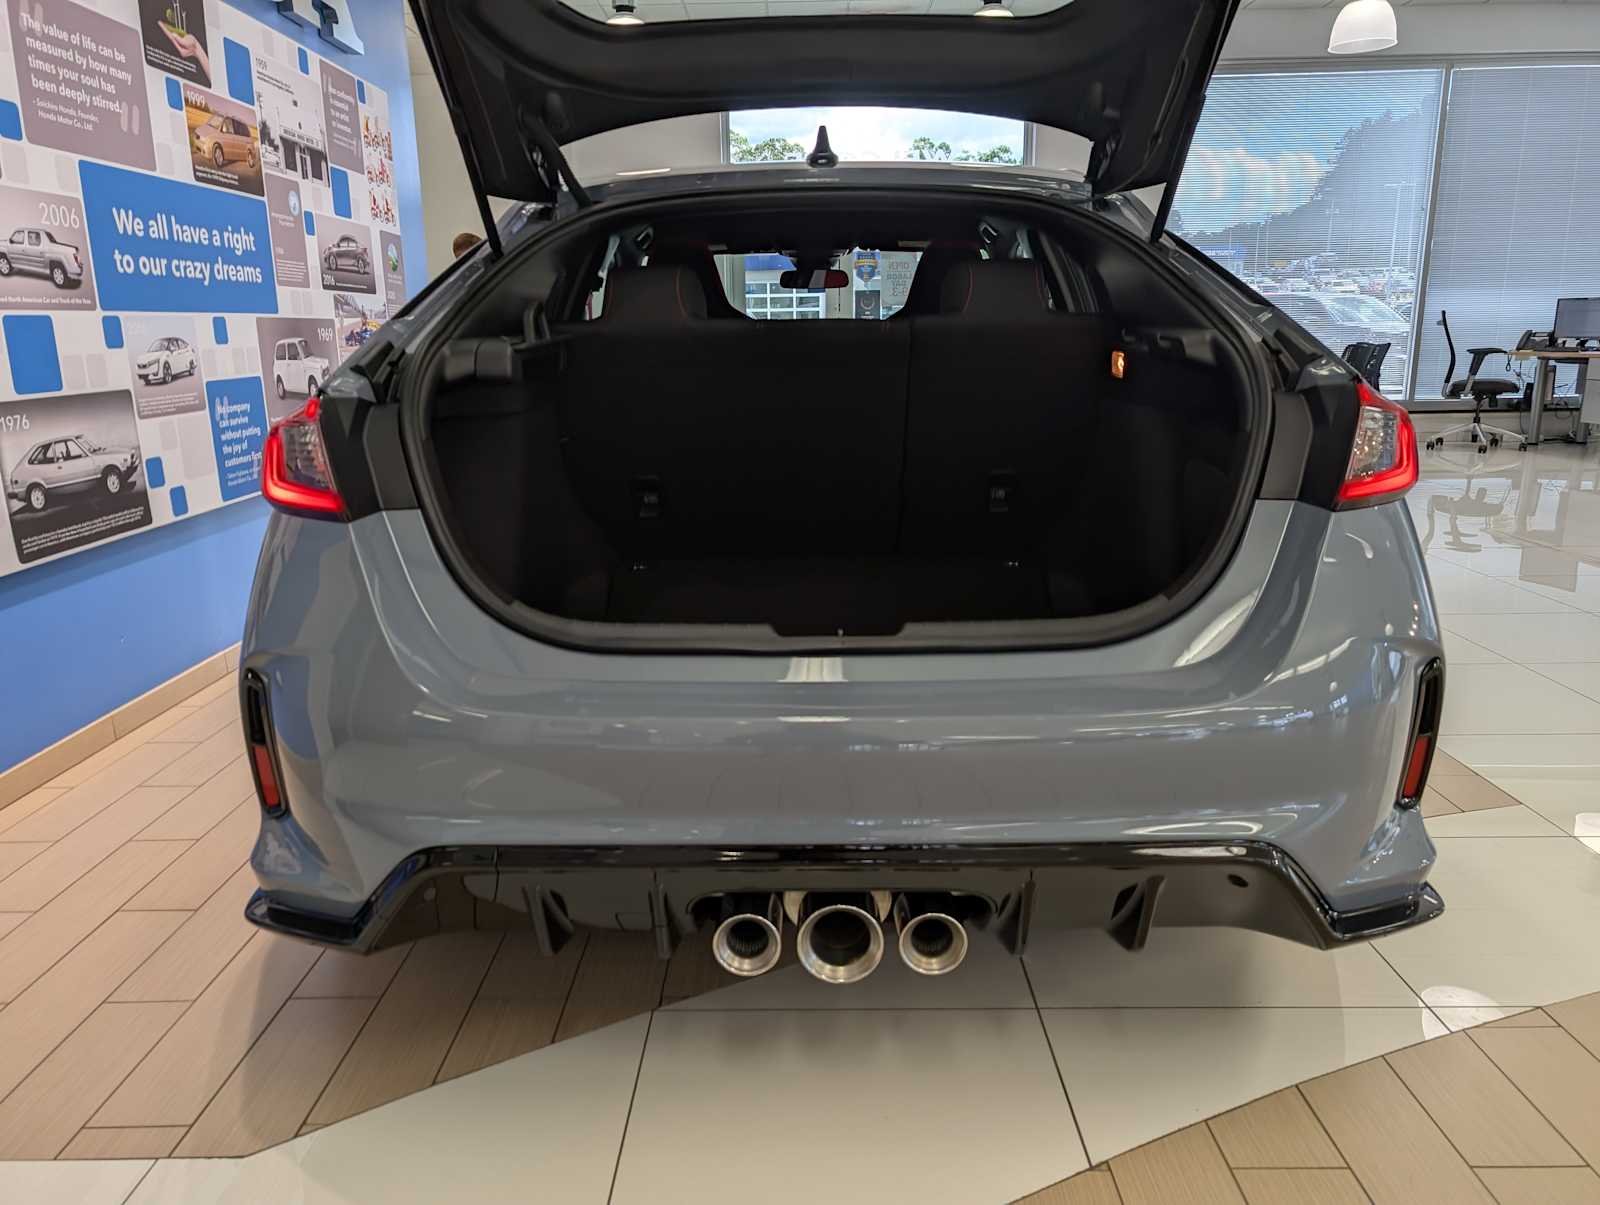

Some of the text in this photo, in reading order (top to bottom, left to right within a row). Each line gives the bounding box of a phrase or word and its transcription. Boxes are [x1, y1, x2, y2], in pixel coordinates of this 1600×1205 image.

[20, 12, 41, 29] The
[42, 23, 69, 41] value
[71, 32, 80, 45] of
[81, 34, 97, 52] life
[98, 45, 113, 58] can
[114, 47, 126, 63] be
[25, 37, 132, 86] measured by how many
[28, 54, 116, 94] times your soul has
[31, 73, 122, 113] been deeply stirred.
[39, 202, 80, 230] 2006
[112, 207, 256, 257] We all have a right
[113, 249, 134, 274] to
[139, 256, 167, 277] our
[171, 259, 210, 286] crazy
[213, 257, 262, 284] dreams
[317, 328, 333, 342] 1969
[226, 403, 250, 413] company
[0, 413, 30, 432] 1976
[219, 416, 248, 428] can survive
[220, 426, 261, 441] without putting
[223, 440, 248, 455] the joy of
[224, 455, 252, 467] customers
